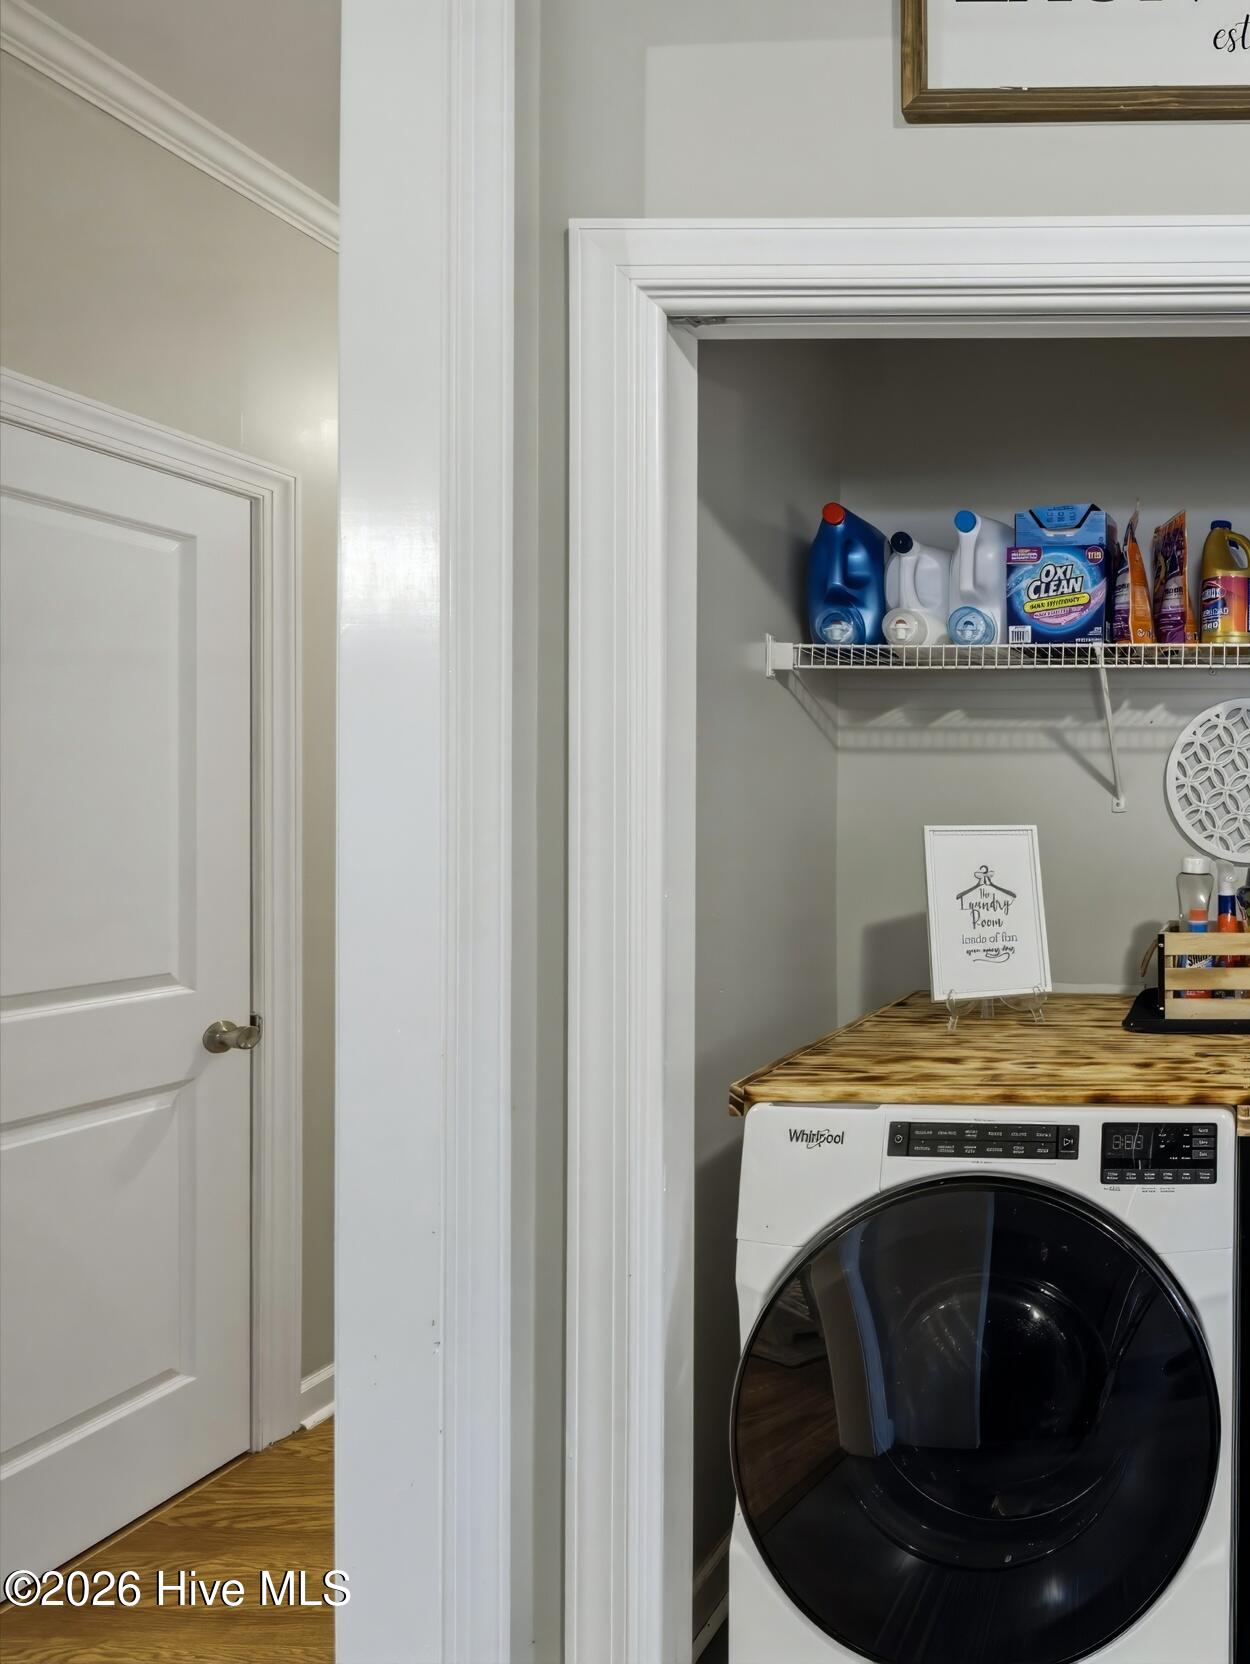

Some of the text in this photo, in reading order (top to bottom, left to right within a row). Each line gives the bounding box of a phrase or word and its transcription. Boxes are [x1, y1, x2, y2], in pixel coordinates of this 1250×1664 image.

[1040, 563, 1073, 583] OXI
[1027, 576, 1084, 600] CLEAN
[960, 893, 1013, 915] Laundry
[971, 909, 1004, 929] Room
[962, 931, 1018, 945] loads of fun
[788, 1128, 845, 1150] Whirlpool
